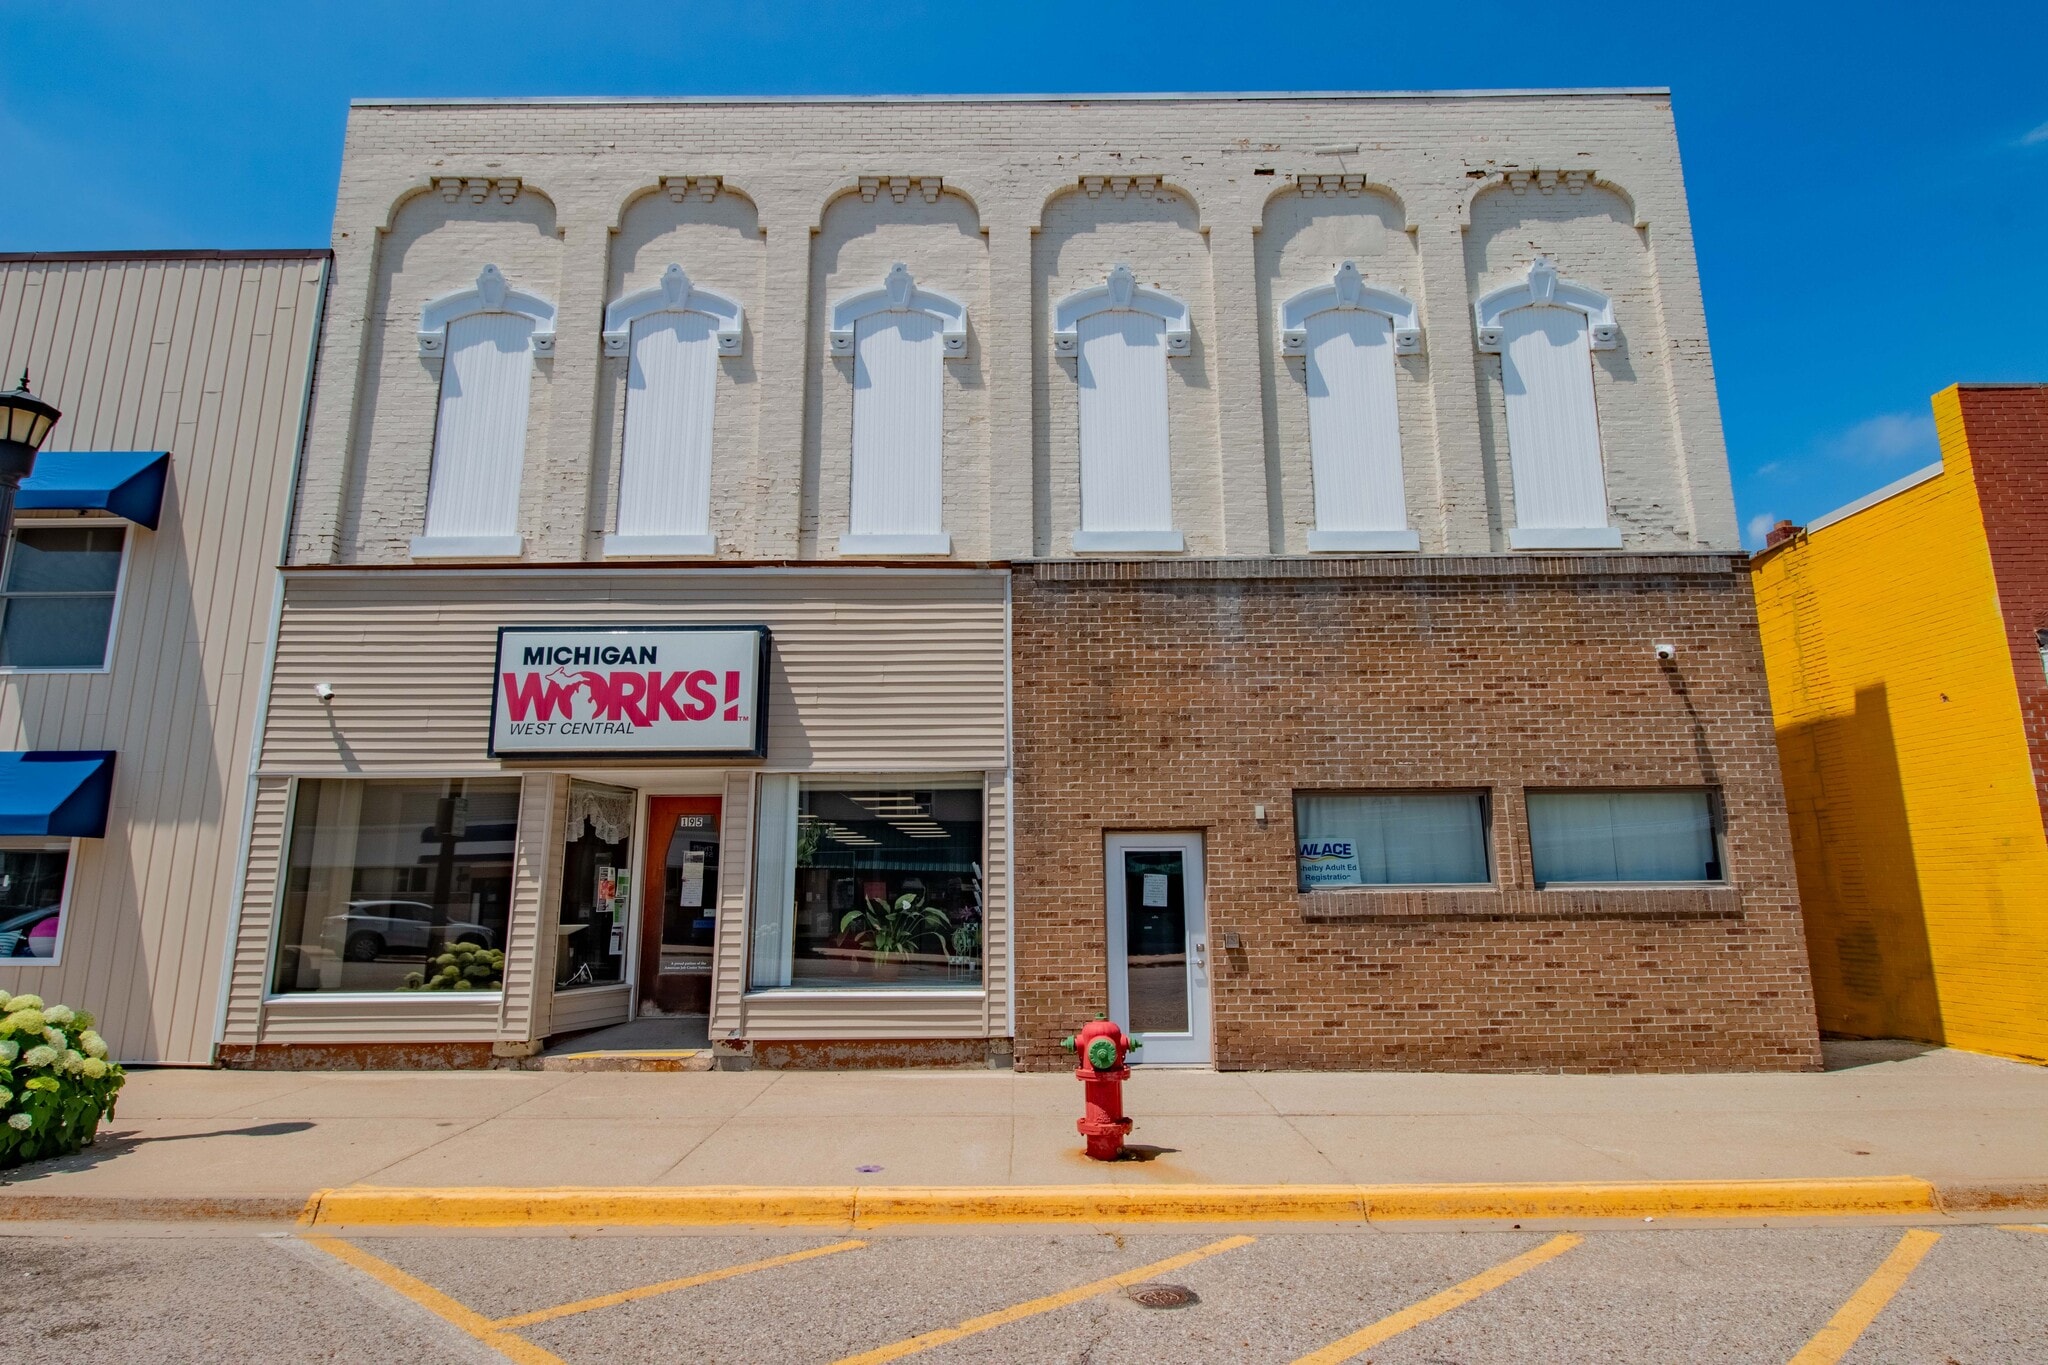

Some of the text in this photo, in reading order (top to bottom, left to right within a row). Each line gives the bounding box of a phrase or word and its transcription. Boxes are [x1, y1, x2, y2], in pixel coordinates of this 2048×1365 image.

[523, 646, 657, 666] MICHIGAN
[510, 722, 634, 735] WEST CENTRAL
[681, 817, 703, 828] 195
[1300, 864, 1323, 872] helby
